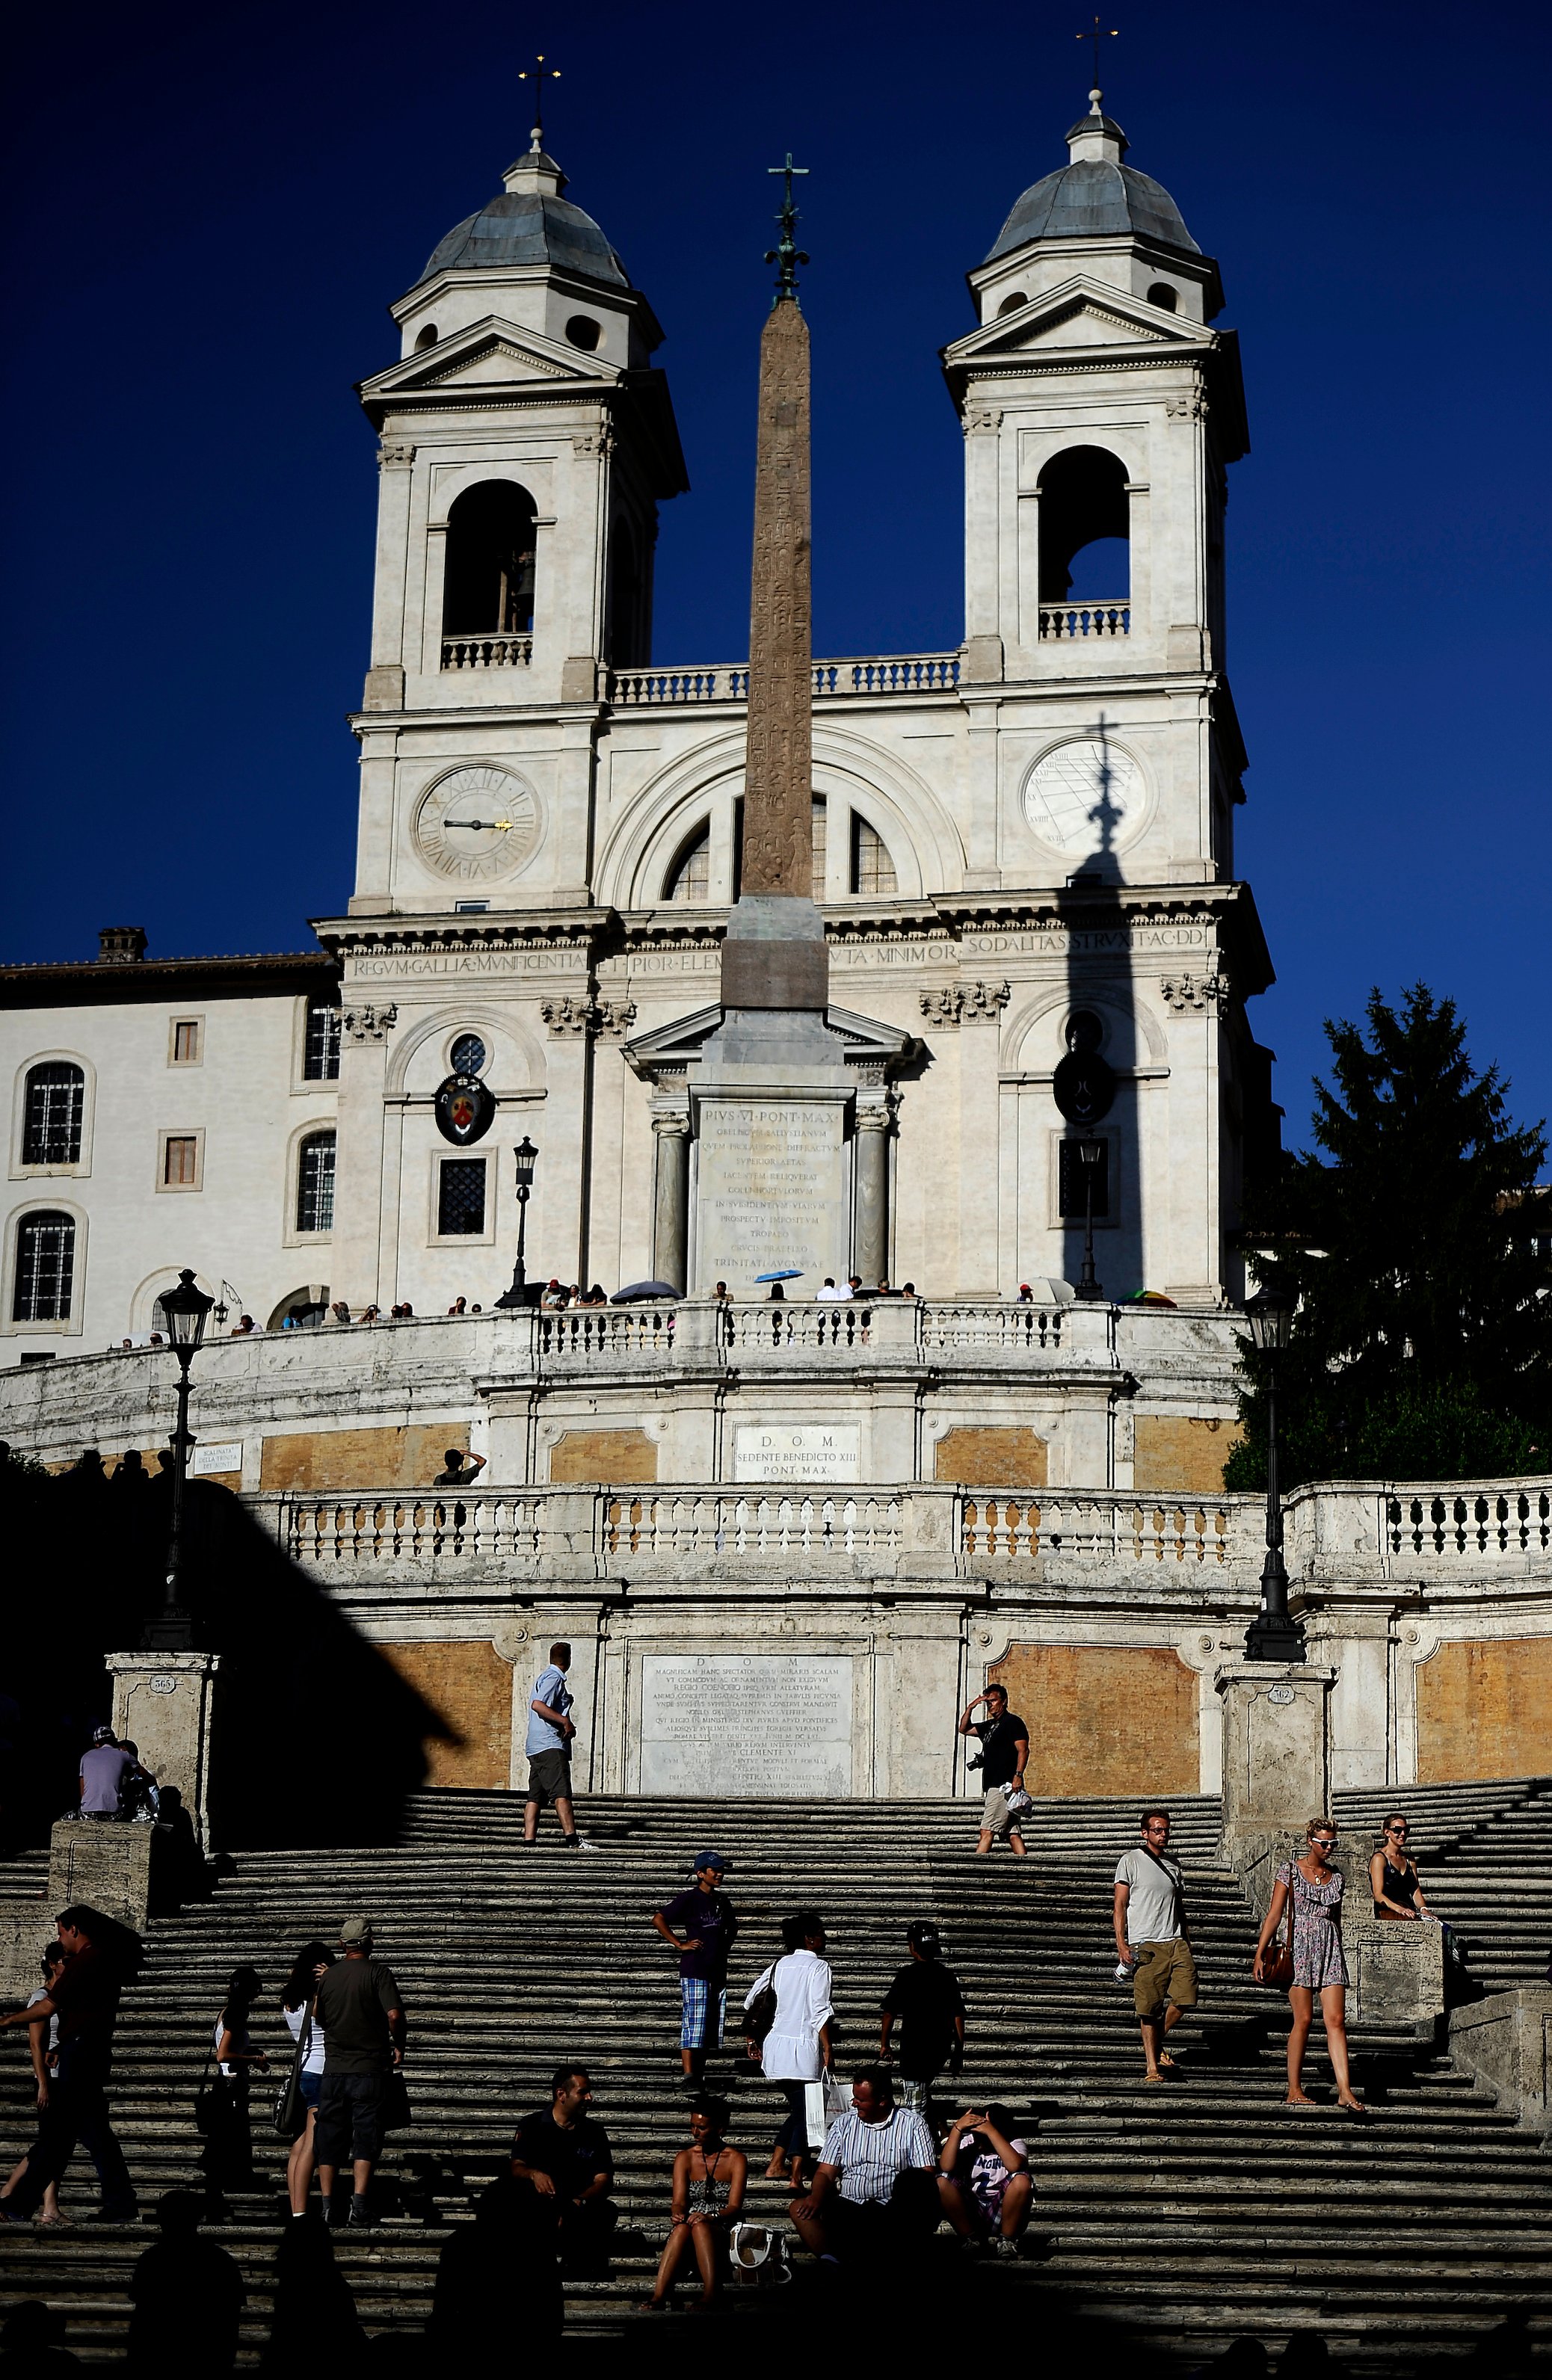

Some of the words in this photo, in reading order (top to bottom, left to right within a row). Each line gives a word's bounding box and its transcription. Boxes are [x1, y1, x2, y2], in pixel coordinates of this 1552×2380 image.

[354, 959, 409, 976] REGVM
[878, 945, 957, 963] MINIMOR
[969, 934, 1066, 952] SODALITAS
[1071, 929, 1149, 950] STRVXIT
[1151, 929, 1174, 947] AC
[706, 1111, 735, 1121] PIVS
[740, 1110, 754, 1121] VI
[737, 1453, 780, 1462] SEDENTE
[783, 1453, 837, 1461] BENEDICTO
[840, 1452, 856, 1461] XIII
